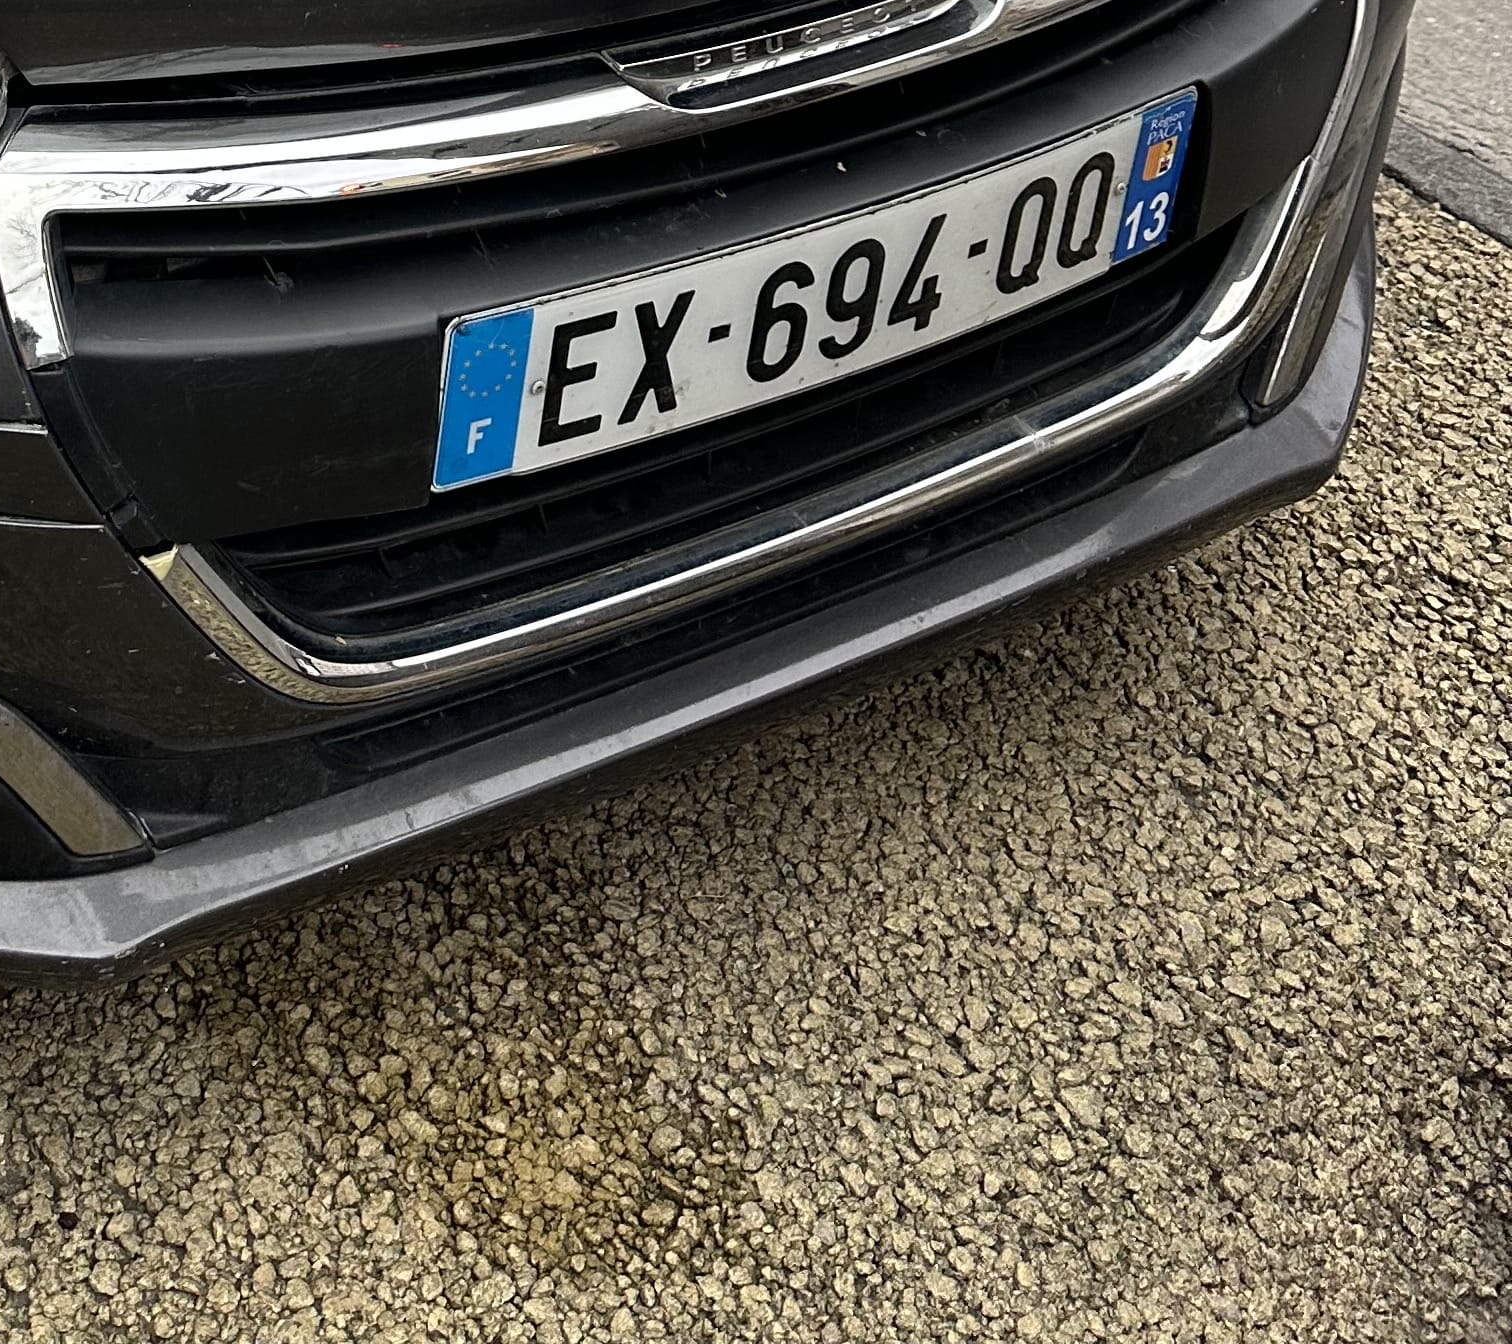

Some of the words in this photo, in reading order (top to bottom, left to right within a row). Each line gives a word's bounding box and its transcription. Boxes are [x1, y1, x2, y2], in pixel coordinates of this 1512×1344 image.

[1146, 121, 1184, 146] PACA
[1125, 191, 1170, 251] 13
[537, 150, 1117, 448] EX-694-QQ
[466, 417, 493, 455] F
